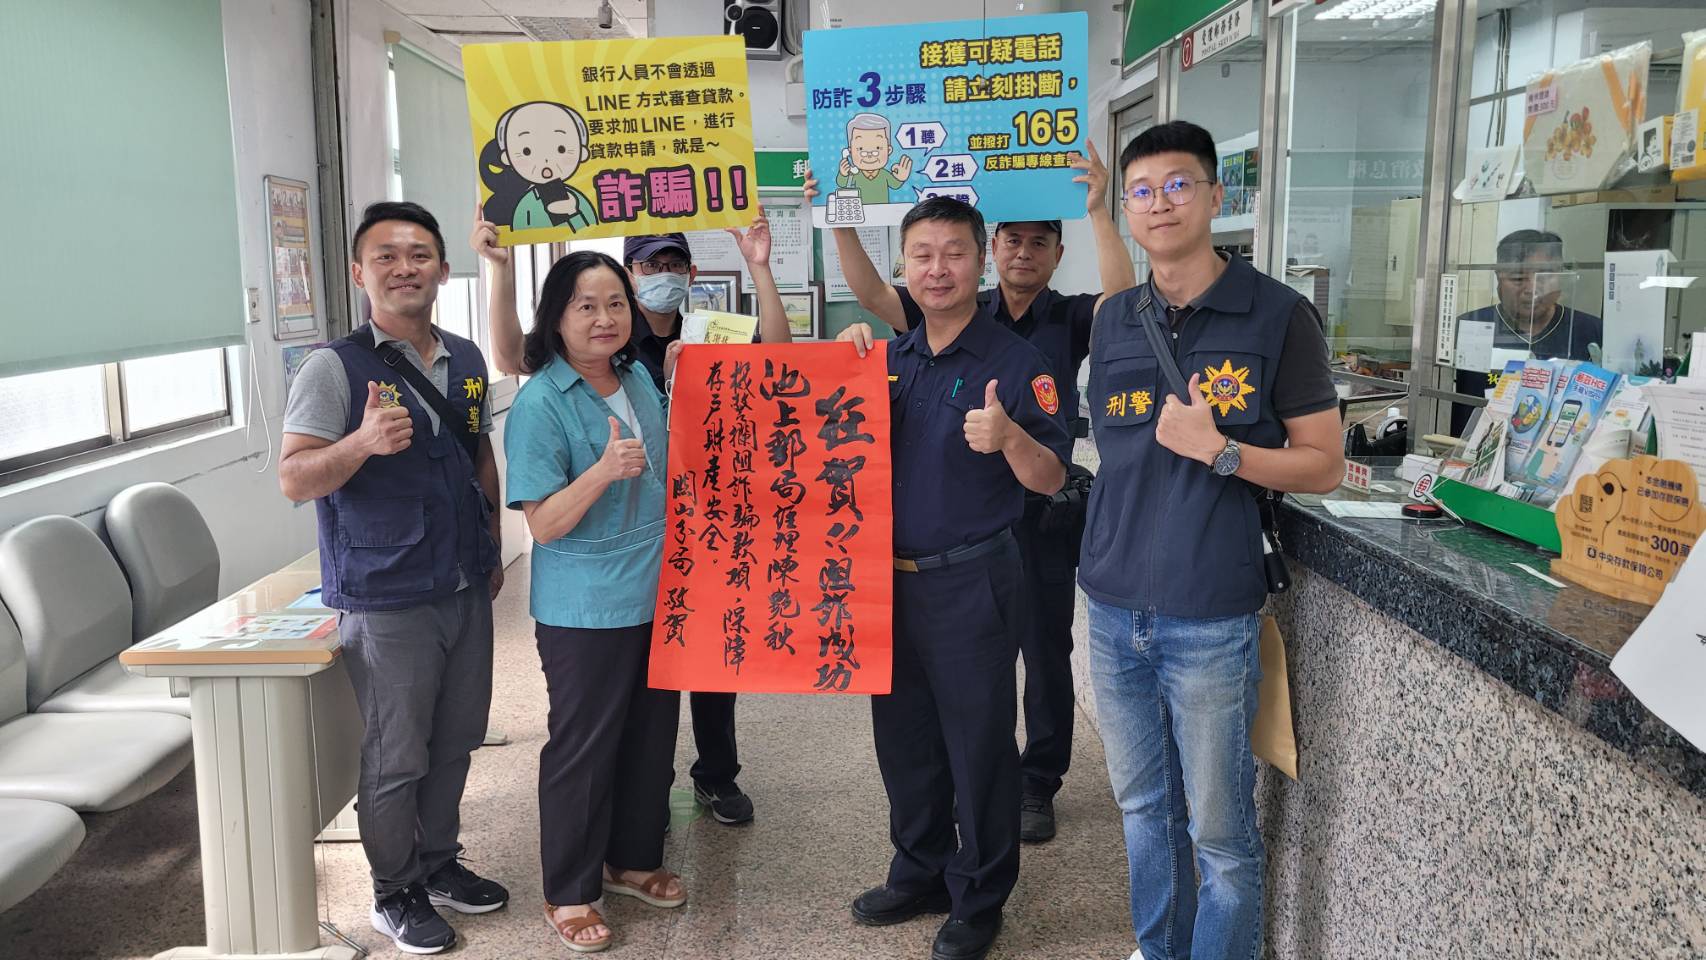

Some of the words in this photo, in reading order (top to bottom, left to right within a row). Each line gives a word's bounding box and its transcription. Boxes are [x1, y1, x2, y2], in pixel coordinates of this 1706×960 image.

[920, 34, 1062, 67] 接獲可疑電話
[582, 62, 715, 82] 銀行人員不會透過
[943, 70, 1079, 103] 請立刻掛斷，
[812, 71, 927, 110] 防詐3步驟
[1012, 108, 1079, 147] 165
[1106, 390, 1153, 417] 刑警
[1598, 552, 1664, 580] 中央存款保險公司
